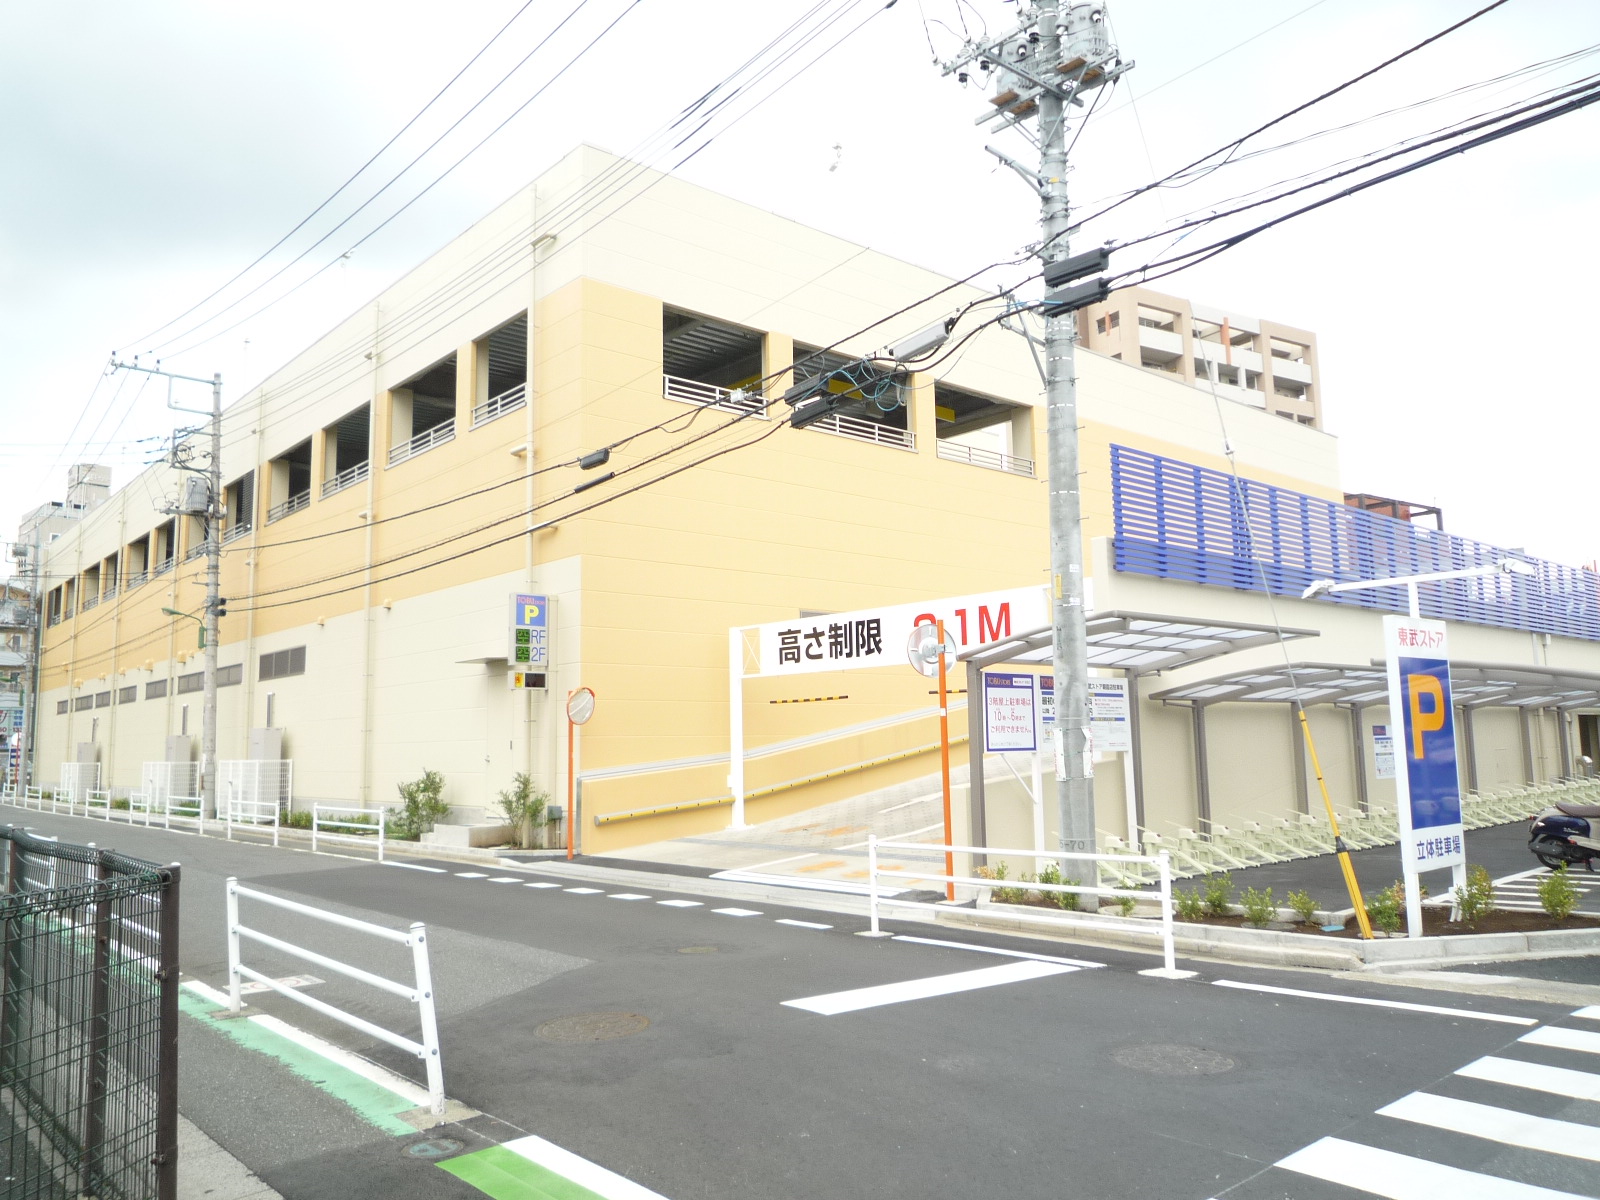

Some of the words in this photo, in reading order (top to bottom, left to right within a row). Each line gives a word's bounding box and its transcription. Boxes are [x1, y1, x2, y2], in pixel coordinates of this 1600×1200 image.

[525, 605, 539, 624] P
[531, 630, 546, 644] RF
[778, 618, 882, 665] 高さ制限
[1398, 627, 1444, 648] 東武ストア
[531, 647, 546, 661] 2F
[1041, 679, 1055, 689] TOB
[989, 697, 1031, 706] 3階屋上駐車場は
[1407, 674, 1445, 760] P
[1416, 835, 1461, 860] 立体駐車場
